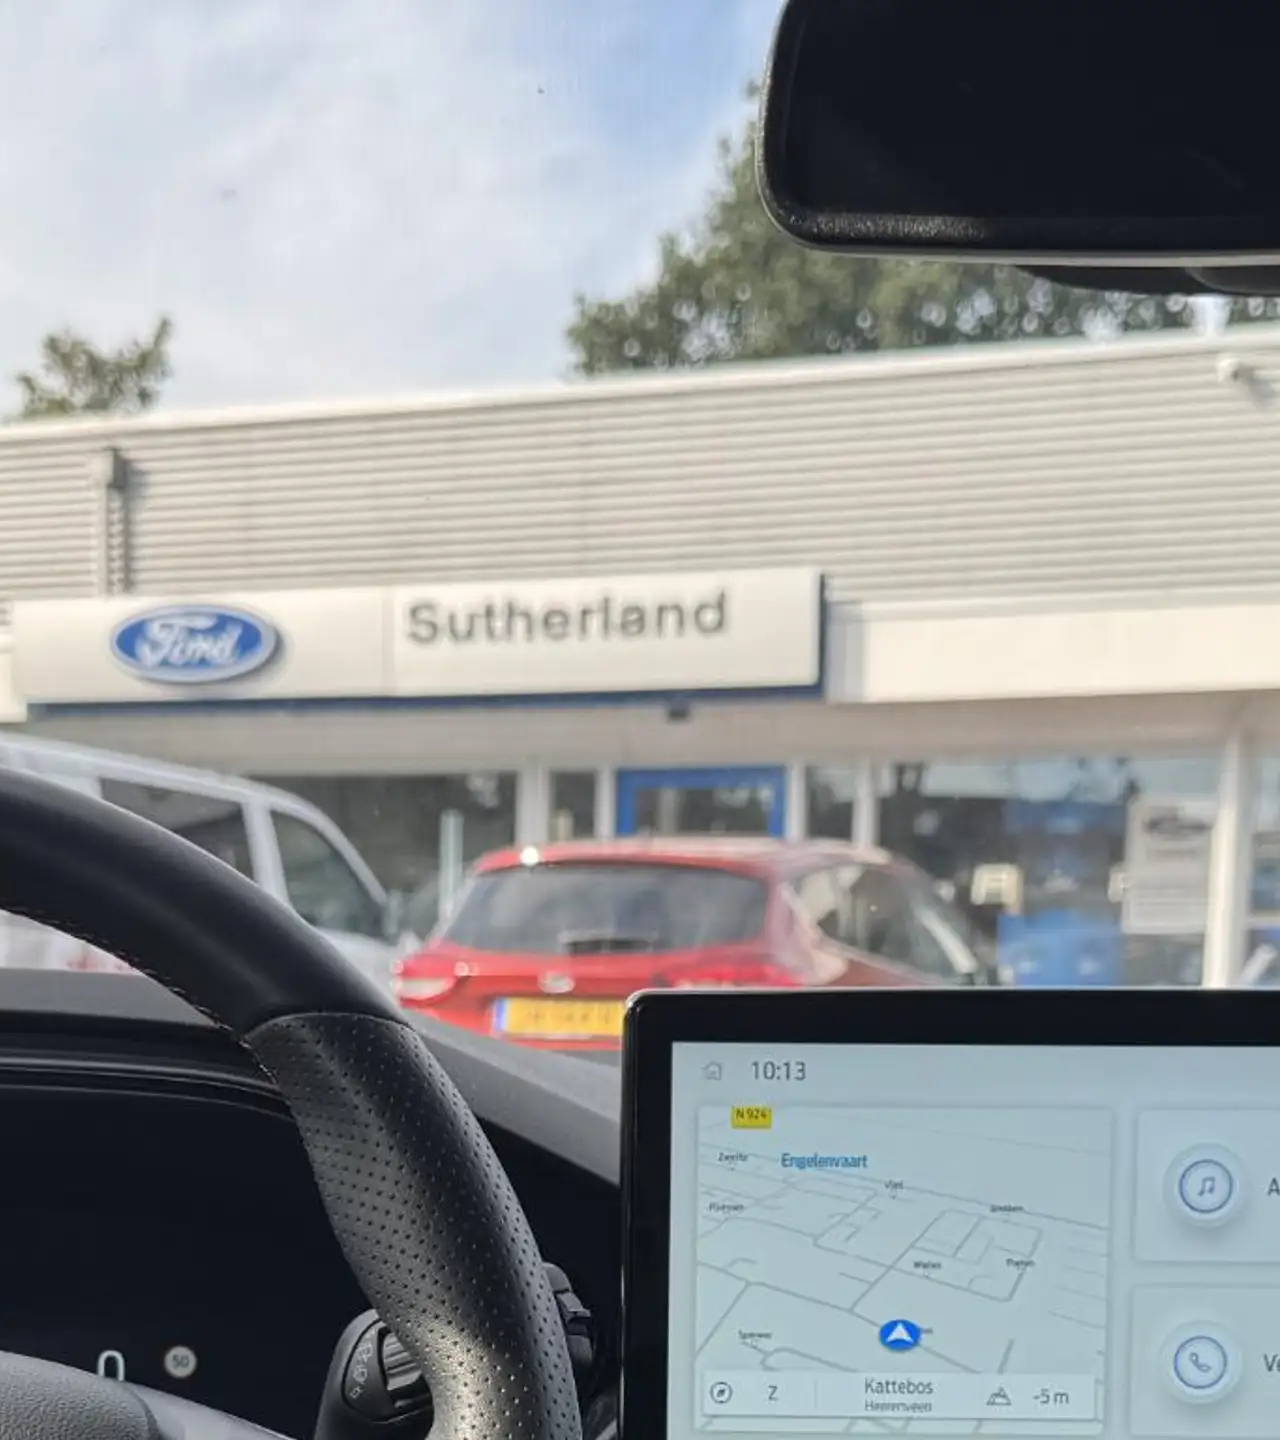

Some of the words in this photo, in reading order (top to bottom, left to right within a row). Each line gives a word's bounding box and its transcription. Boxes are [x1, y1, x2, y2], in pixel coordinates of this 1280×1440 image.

[407, 587, 726, 645] Sutherland
[135, 614, 243, 667] Ford
[751, 1060, 807, 1081] 10:13
[780, 1152, 868, 1170] Engelenvaart
[172, 1354, 190, 1369] 50
[767, 1386, 779, 1402] Z
[864, 1377, 934, 1396] Kattebos
[1052, 1391, 1070, 1405] m
